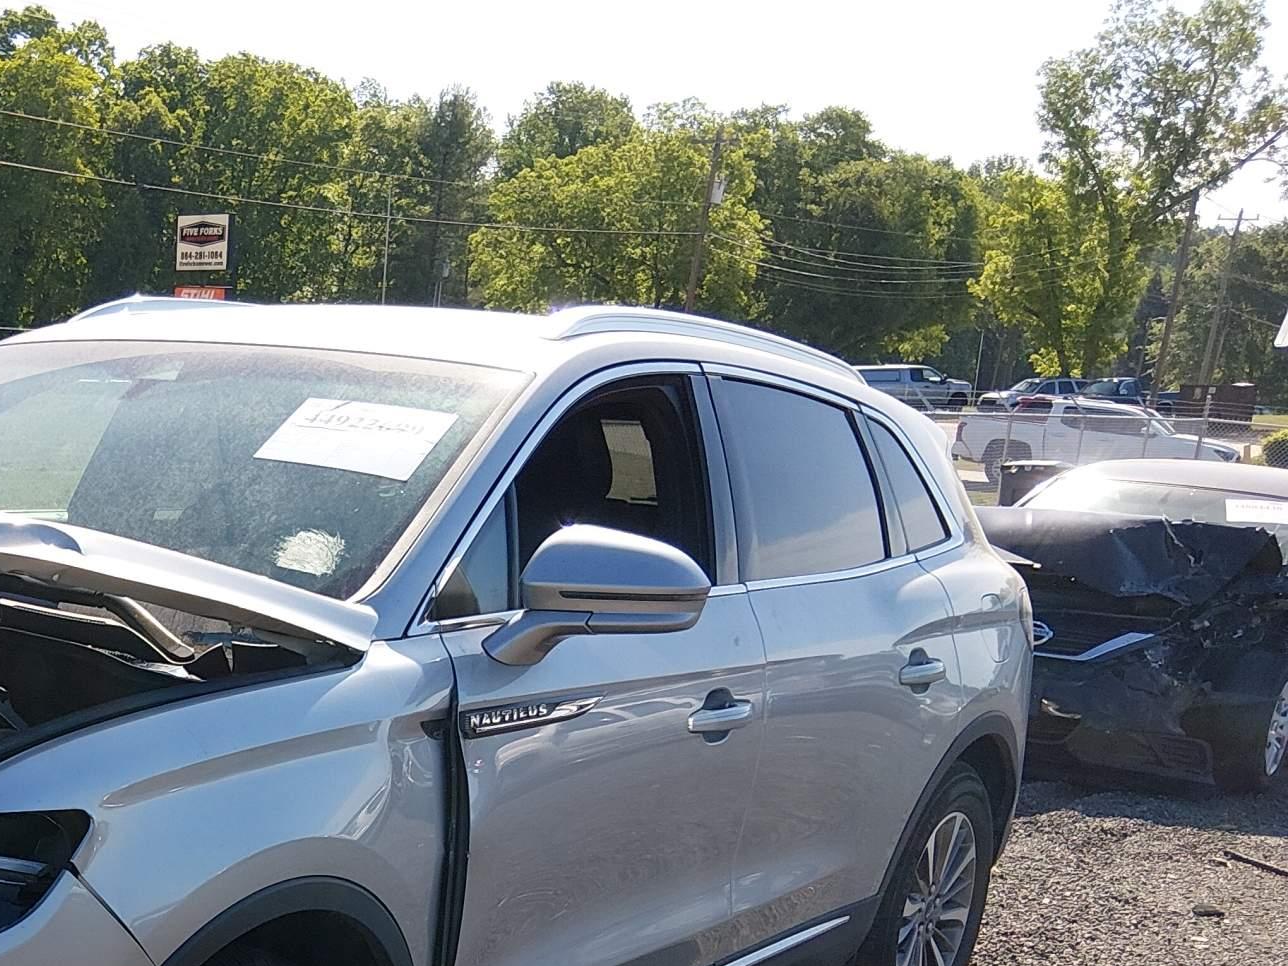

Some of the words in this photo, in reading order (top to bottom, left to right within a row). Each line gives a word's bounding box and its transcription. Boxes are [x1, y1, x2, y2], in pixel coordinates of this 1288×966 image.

[183, 228, 199, 236] FIVE
[200, 227, 223, 235] FORKS
[470, 704, 547, 729] NAUTILUS
